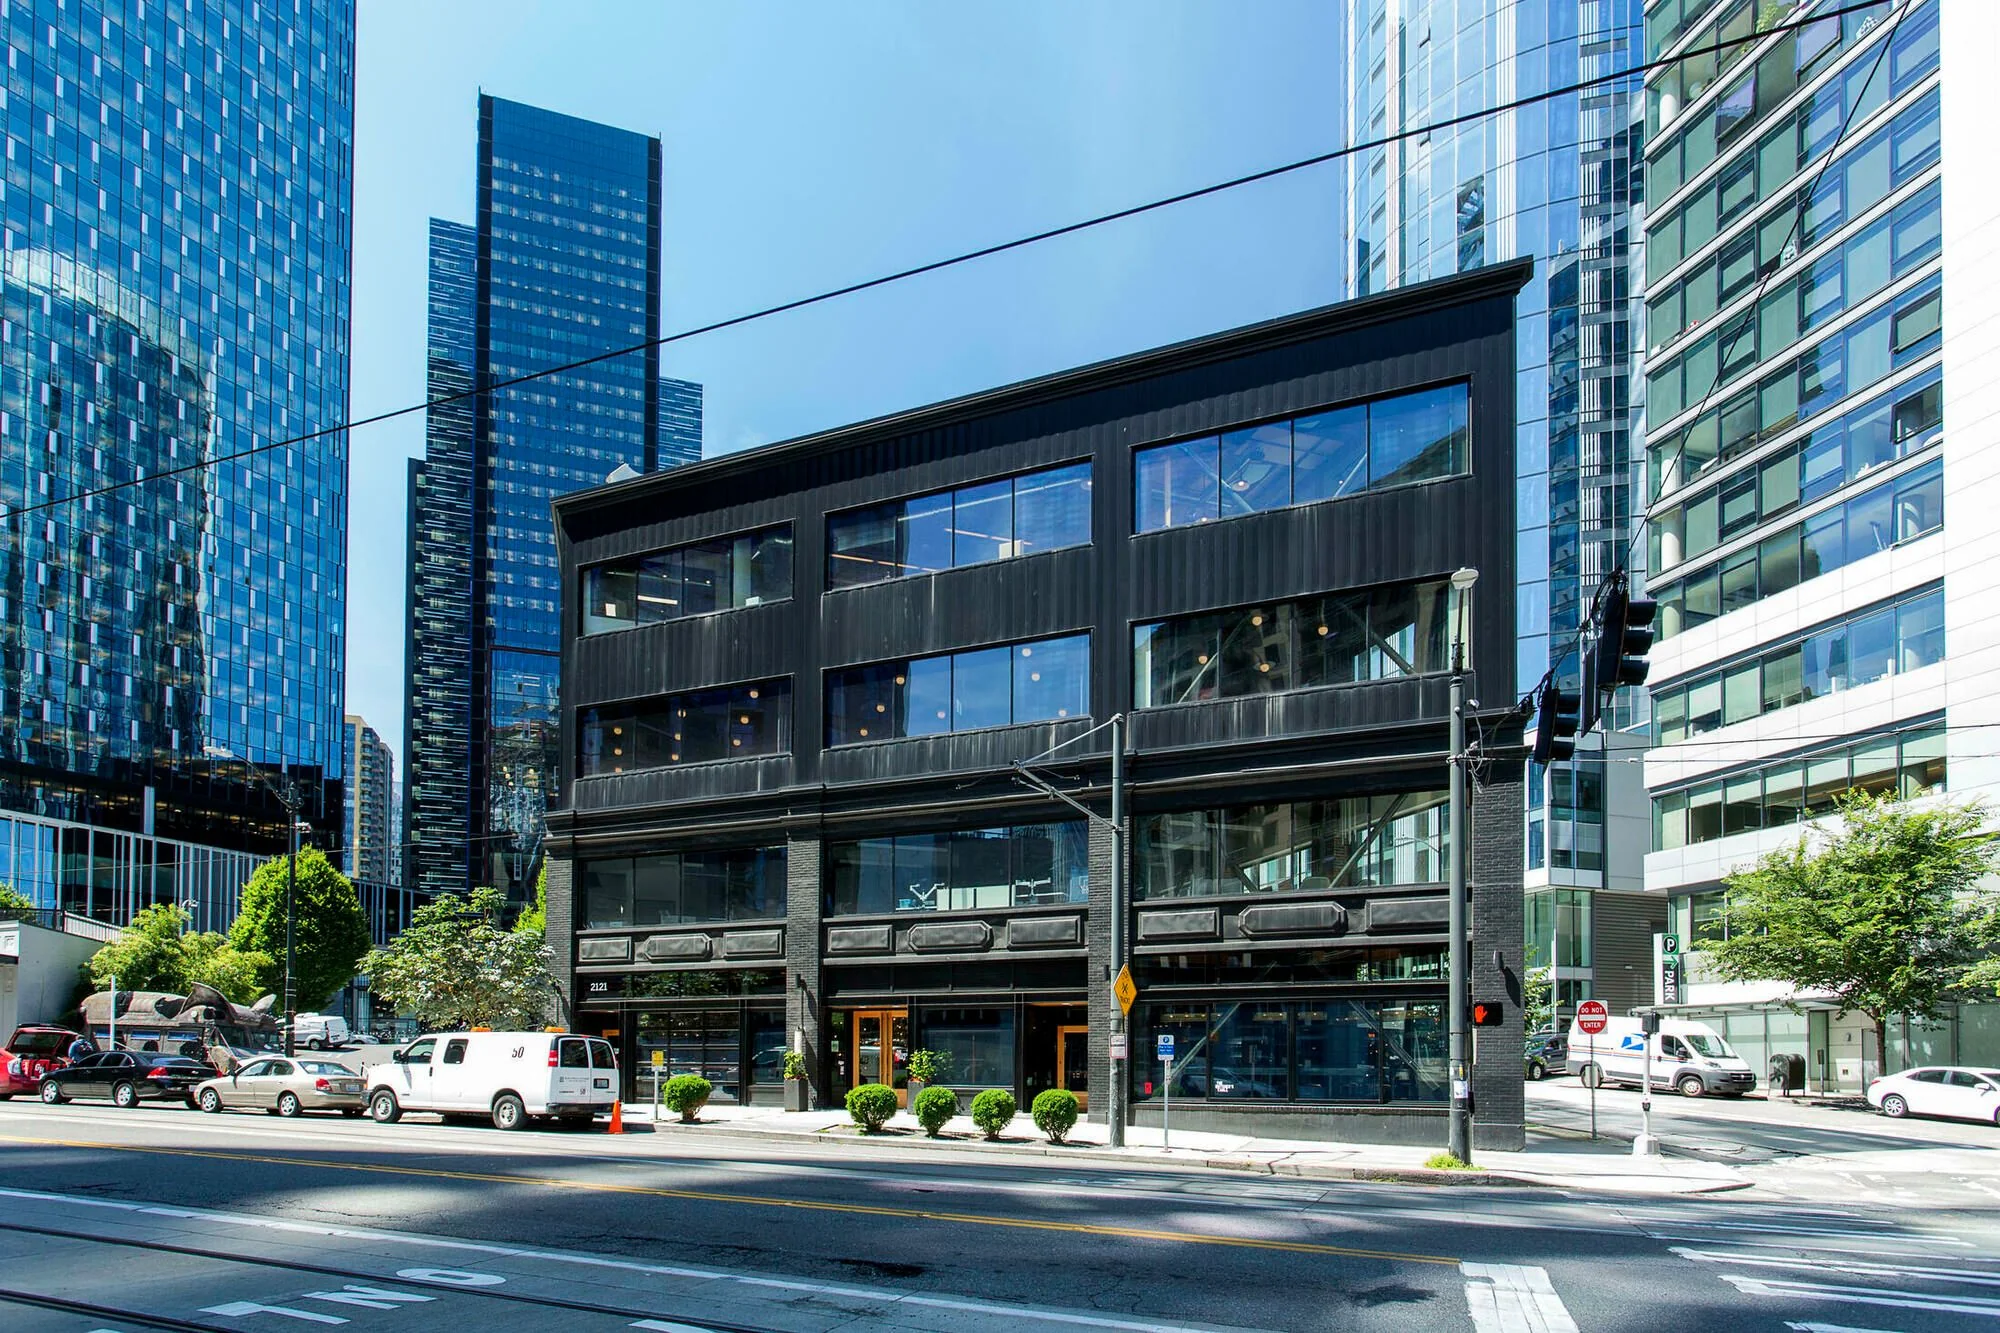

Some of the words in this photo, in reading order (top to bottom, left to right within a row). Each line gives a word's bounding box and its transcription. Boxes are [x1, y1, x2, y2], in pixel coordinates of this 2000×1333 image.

[1667, 938, 1675, 951] P
[590, 982, 608, 992] 2121
[1664, 970, 1675, 1001] PARK
[511, 1046, 525, 1059] 50
[88, 1268, 506, 1333] ONL
